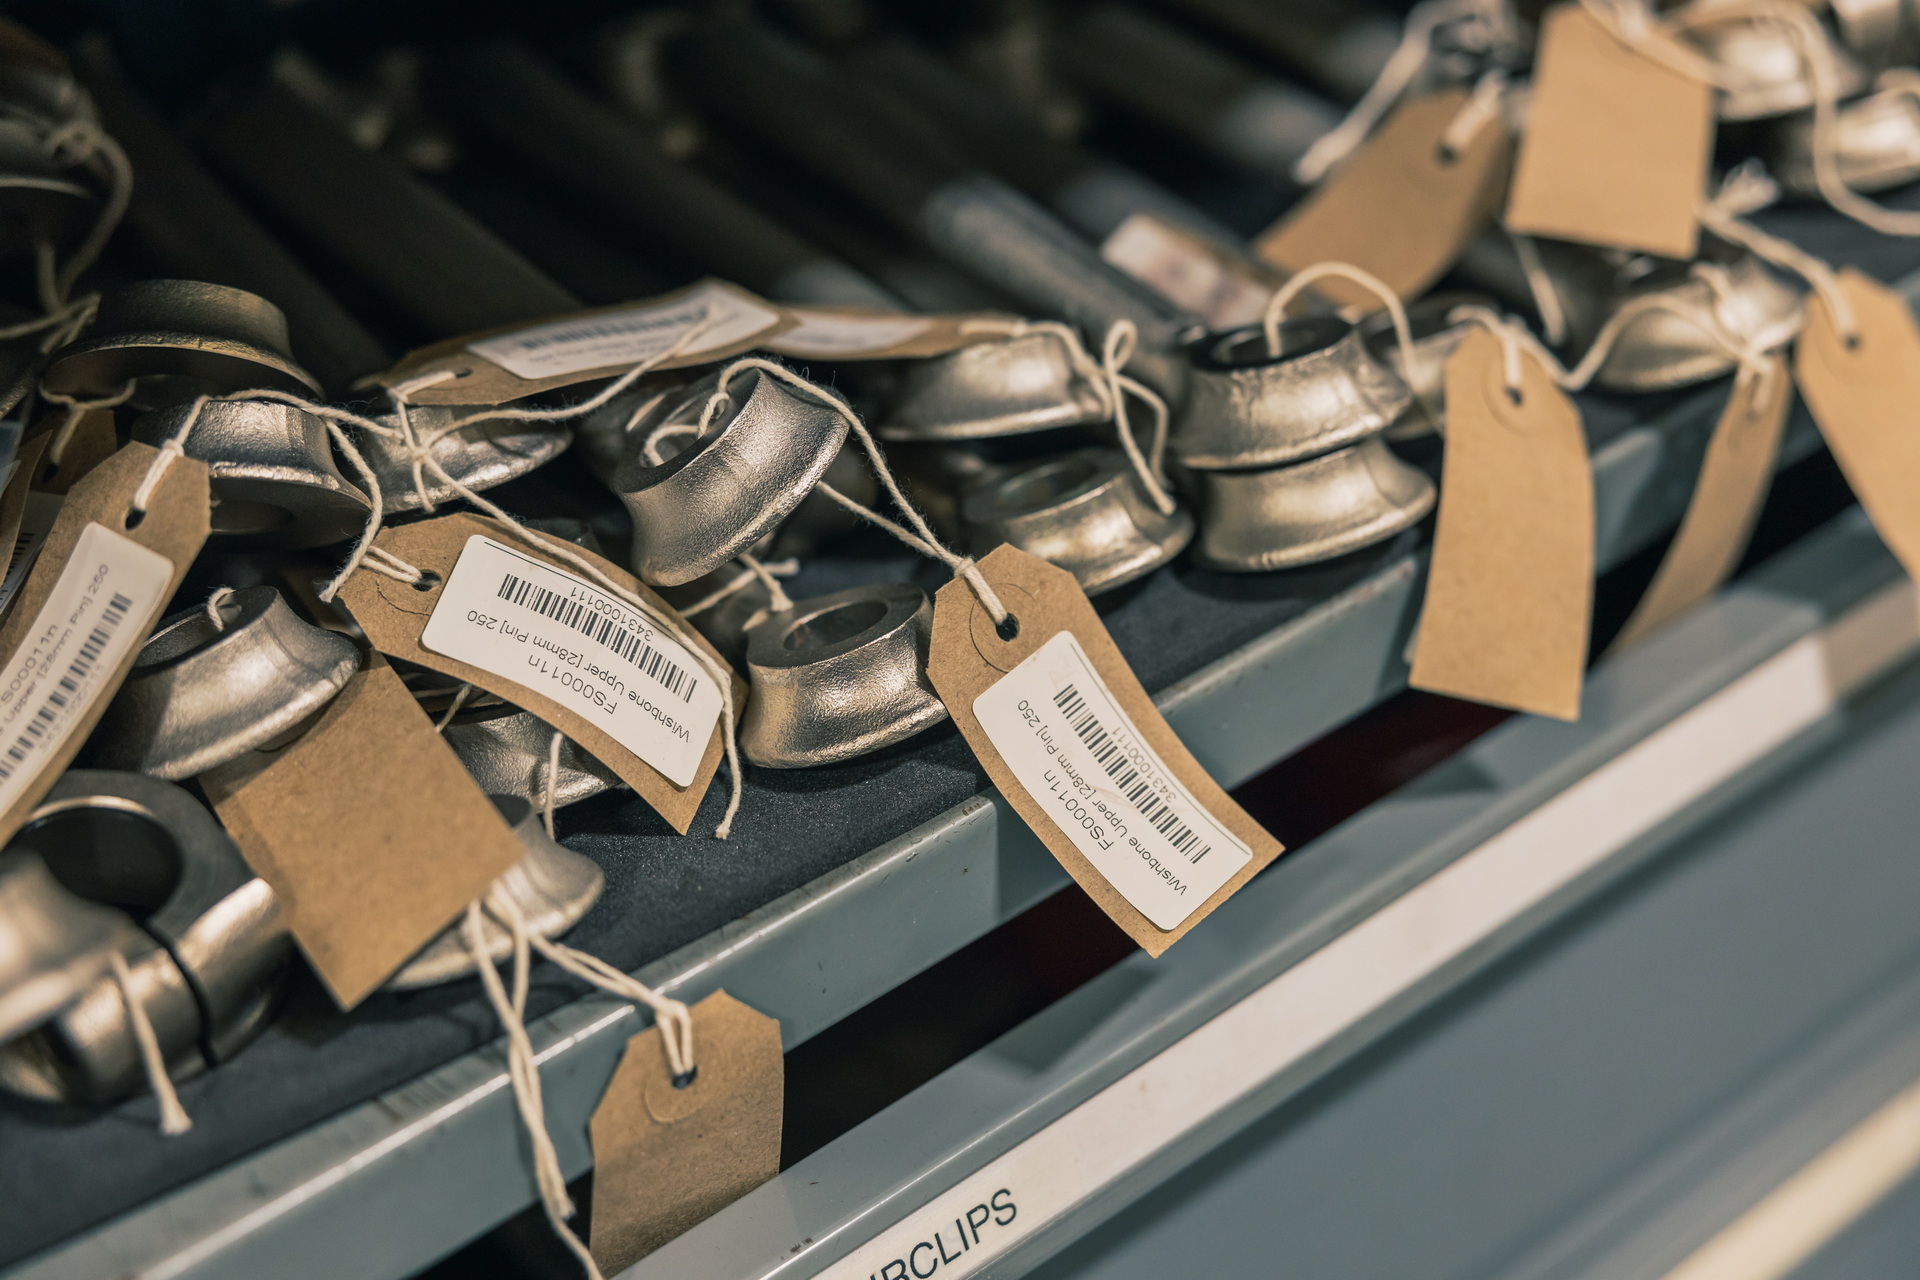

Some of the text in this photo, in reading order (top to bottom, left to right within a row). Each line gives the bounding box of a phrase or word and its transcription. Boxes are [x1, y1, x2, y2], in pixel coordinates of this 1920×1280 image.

[88, 563, 109, 595] 250
[568, 586, 654, 642] 3431000111
[0, 625, 58, 706] S00011n
[467, 609, 690, 743] Wishbone Upper [28mm Pin] 250
[527, 654, 618, 716] FS00011n
[1017, 698, 1188, 896] Wishbone Upper [28mm Pin] 250
[1111, 725, 1177, 804] 3431000111
[1042, 768, 1115, 851] FS00011n
[869, 1187, 1018, 1280] RCLIPS
